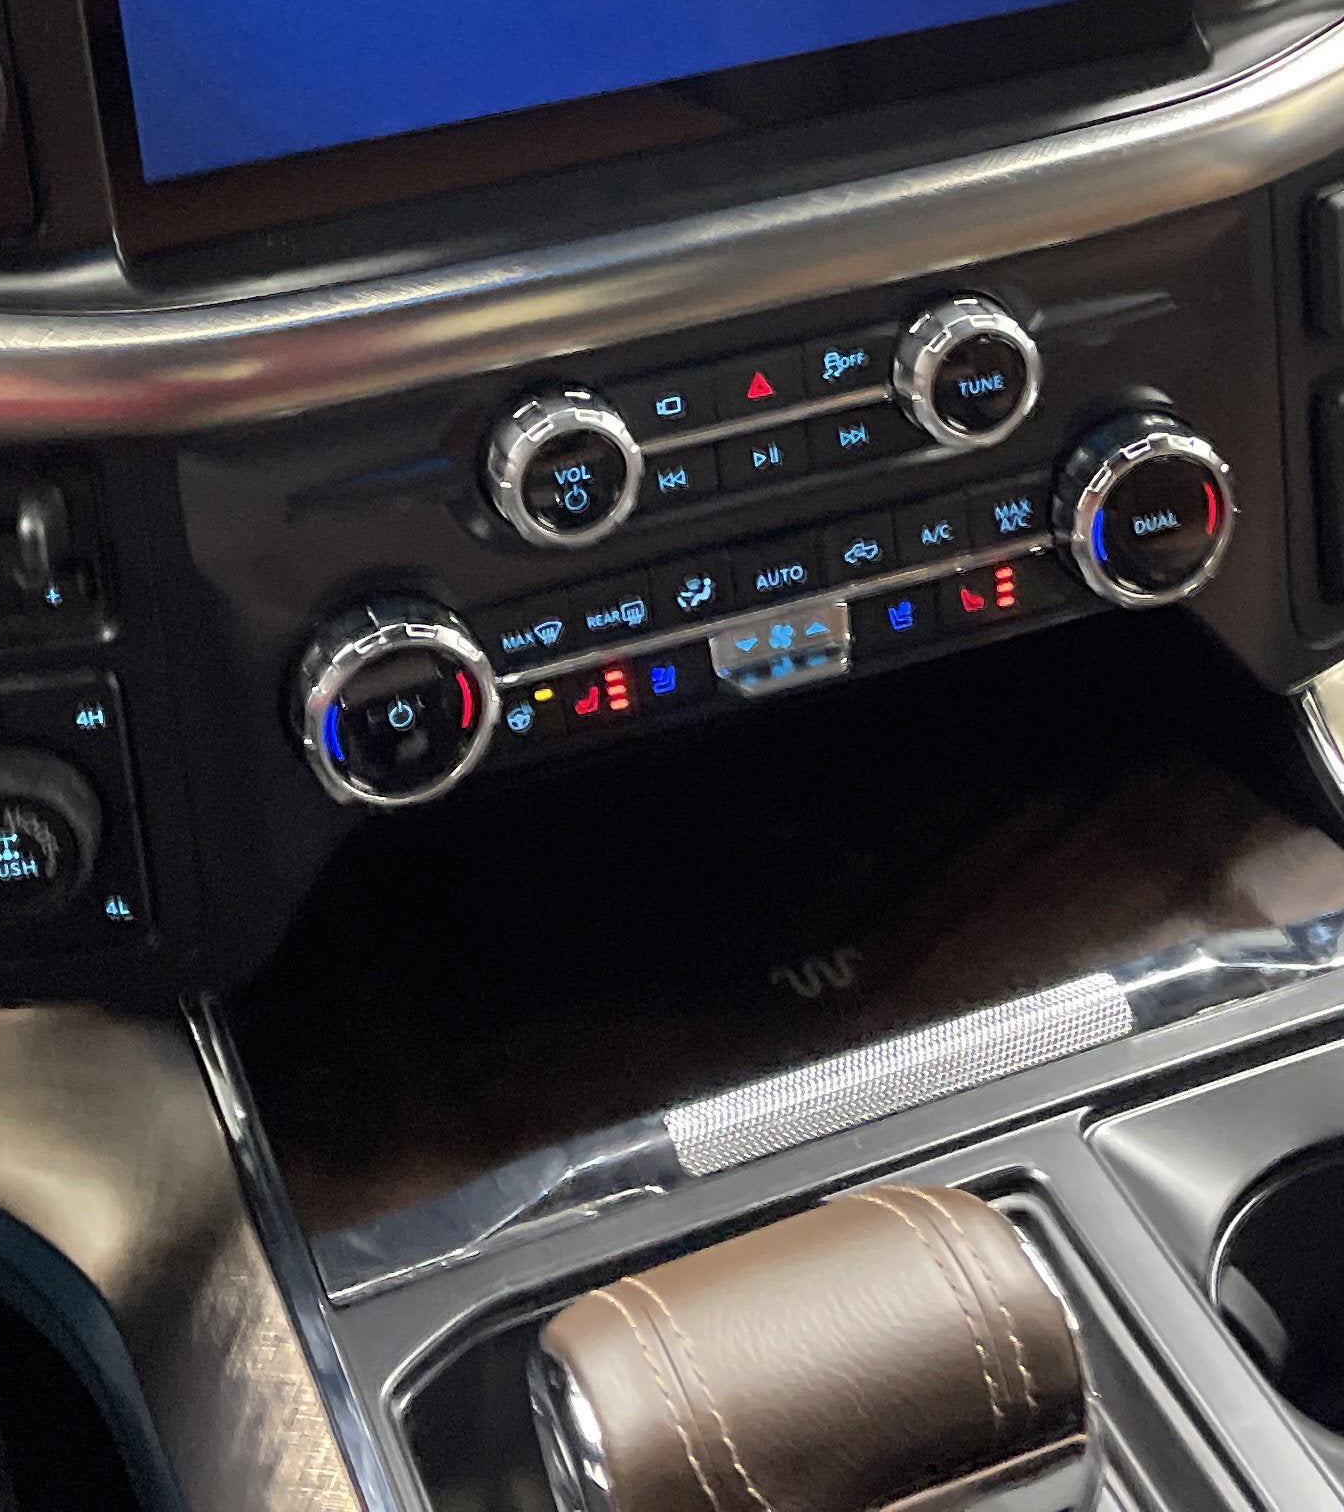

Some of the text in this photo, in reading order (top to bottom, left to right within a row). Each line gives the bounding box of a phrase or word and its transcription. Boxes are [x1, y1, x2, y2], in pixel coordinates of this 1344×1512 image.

[842, 351, 867, 369] OFF
[959, 375, 1006, 397] TUNE
[554, 465, 591, 485] VOL
[994, 498, 1032, 521] MAX
[1000, 515, 1031, 533] A/C
[1134, 511, 1181, 535] DUAL
[921, 523, 954, 544] A/C
[756, 565, 805, 590] AUTO
[586, 609, 621, 629] REAR
[502, 633, 536, 652] MAX
[76, 709, 104, 728] 4H
[105, 900, 131, 918] 4L
